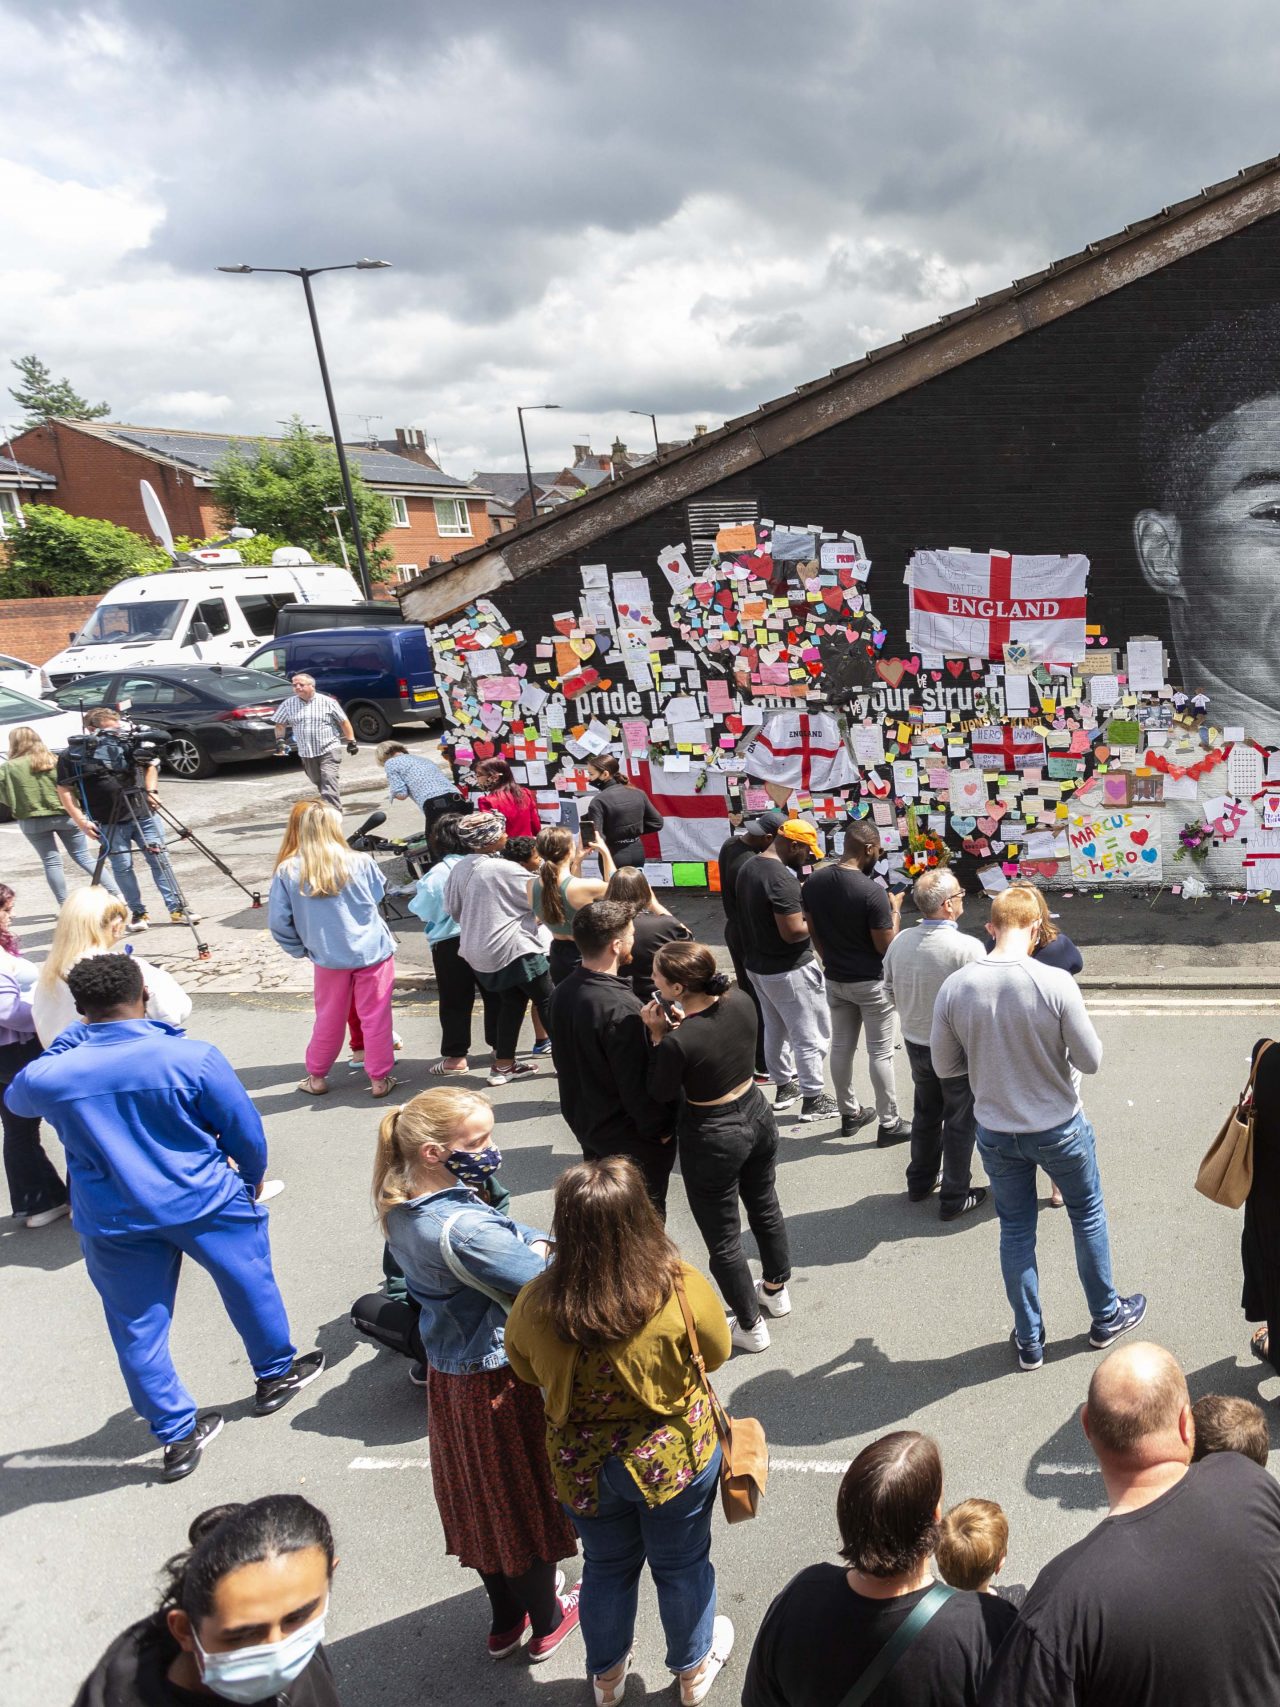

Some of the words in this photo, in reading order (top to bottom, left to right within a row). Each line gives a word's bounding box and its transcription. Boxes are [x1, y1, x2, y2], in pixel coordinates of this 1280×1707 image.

[946, 596, 1061, 618] ENGLAND
[576, 683, 642, 723] pride
[857, 687, 914, 719] your
[922, 681, 1005, 718] strugg
[1070, 813, 1133, 849] MARCUS
[1088, 851, 1138, 875] HERO
